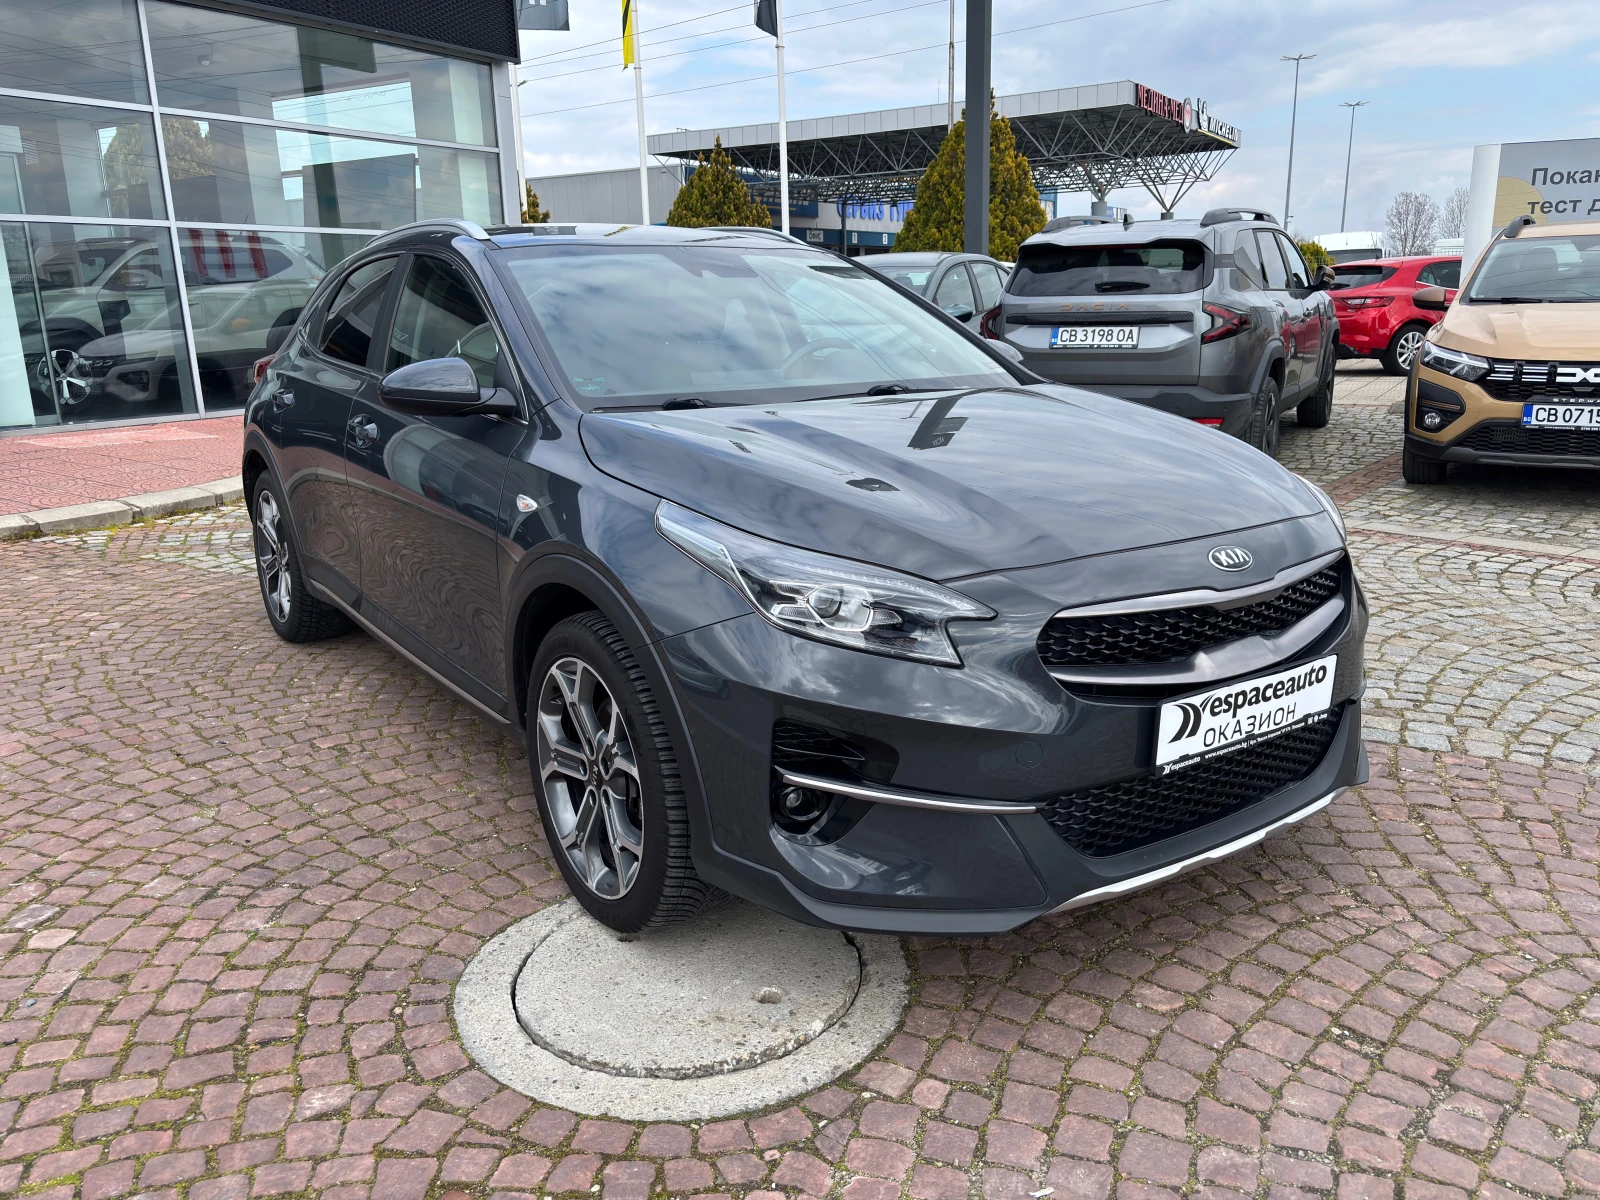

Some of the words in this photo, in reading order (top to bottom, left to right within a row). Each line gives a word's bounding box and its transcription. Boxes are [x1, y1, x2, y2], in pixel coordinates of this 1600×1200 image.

[1209, 117, 1239, 142] MICHELIN
[1527, 199, 1582, 215] тест
[1061, 302, 1129, 311] DACIA
[1060, 329, 1078, 343] CB
[1080, 329, 1113, 343] 3198
[1117, 329, 1134, 343] OA
[1535, 407, 1559, 423] CB
[1214, 548, 1250, 567] KIA
[1210, 664, 1327, 718] espaceauto
[1203, 702, 1297, 748] ОКАЗИОН
[1171, 756, 1201, 771] espaceauto
